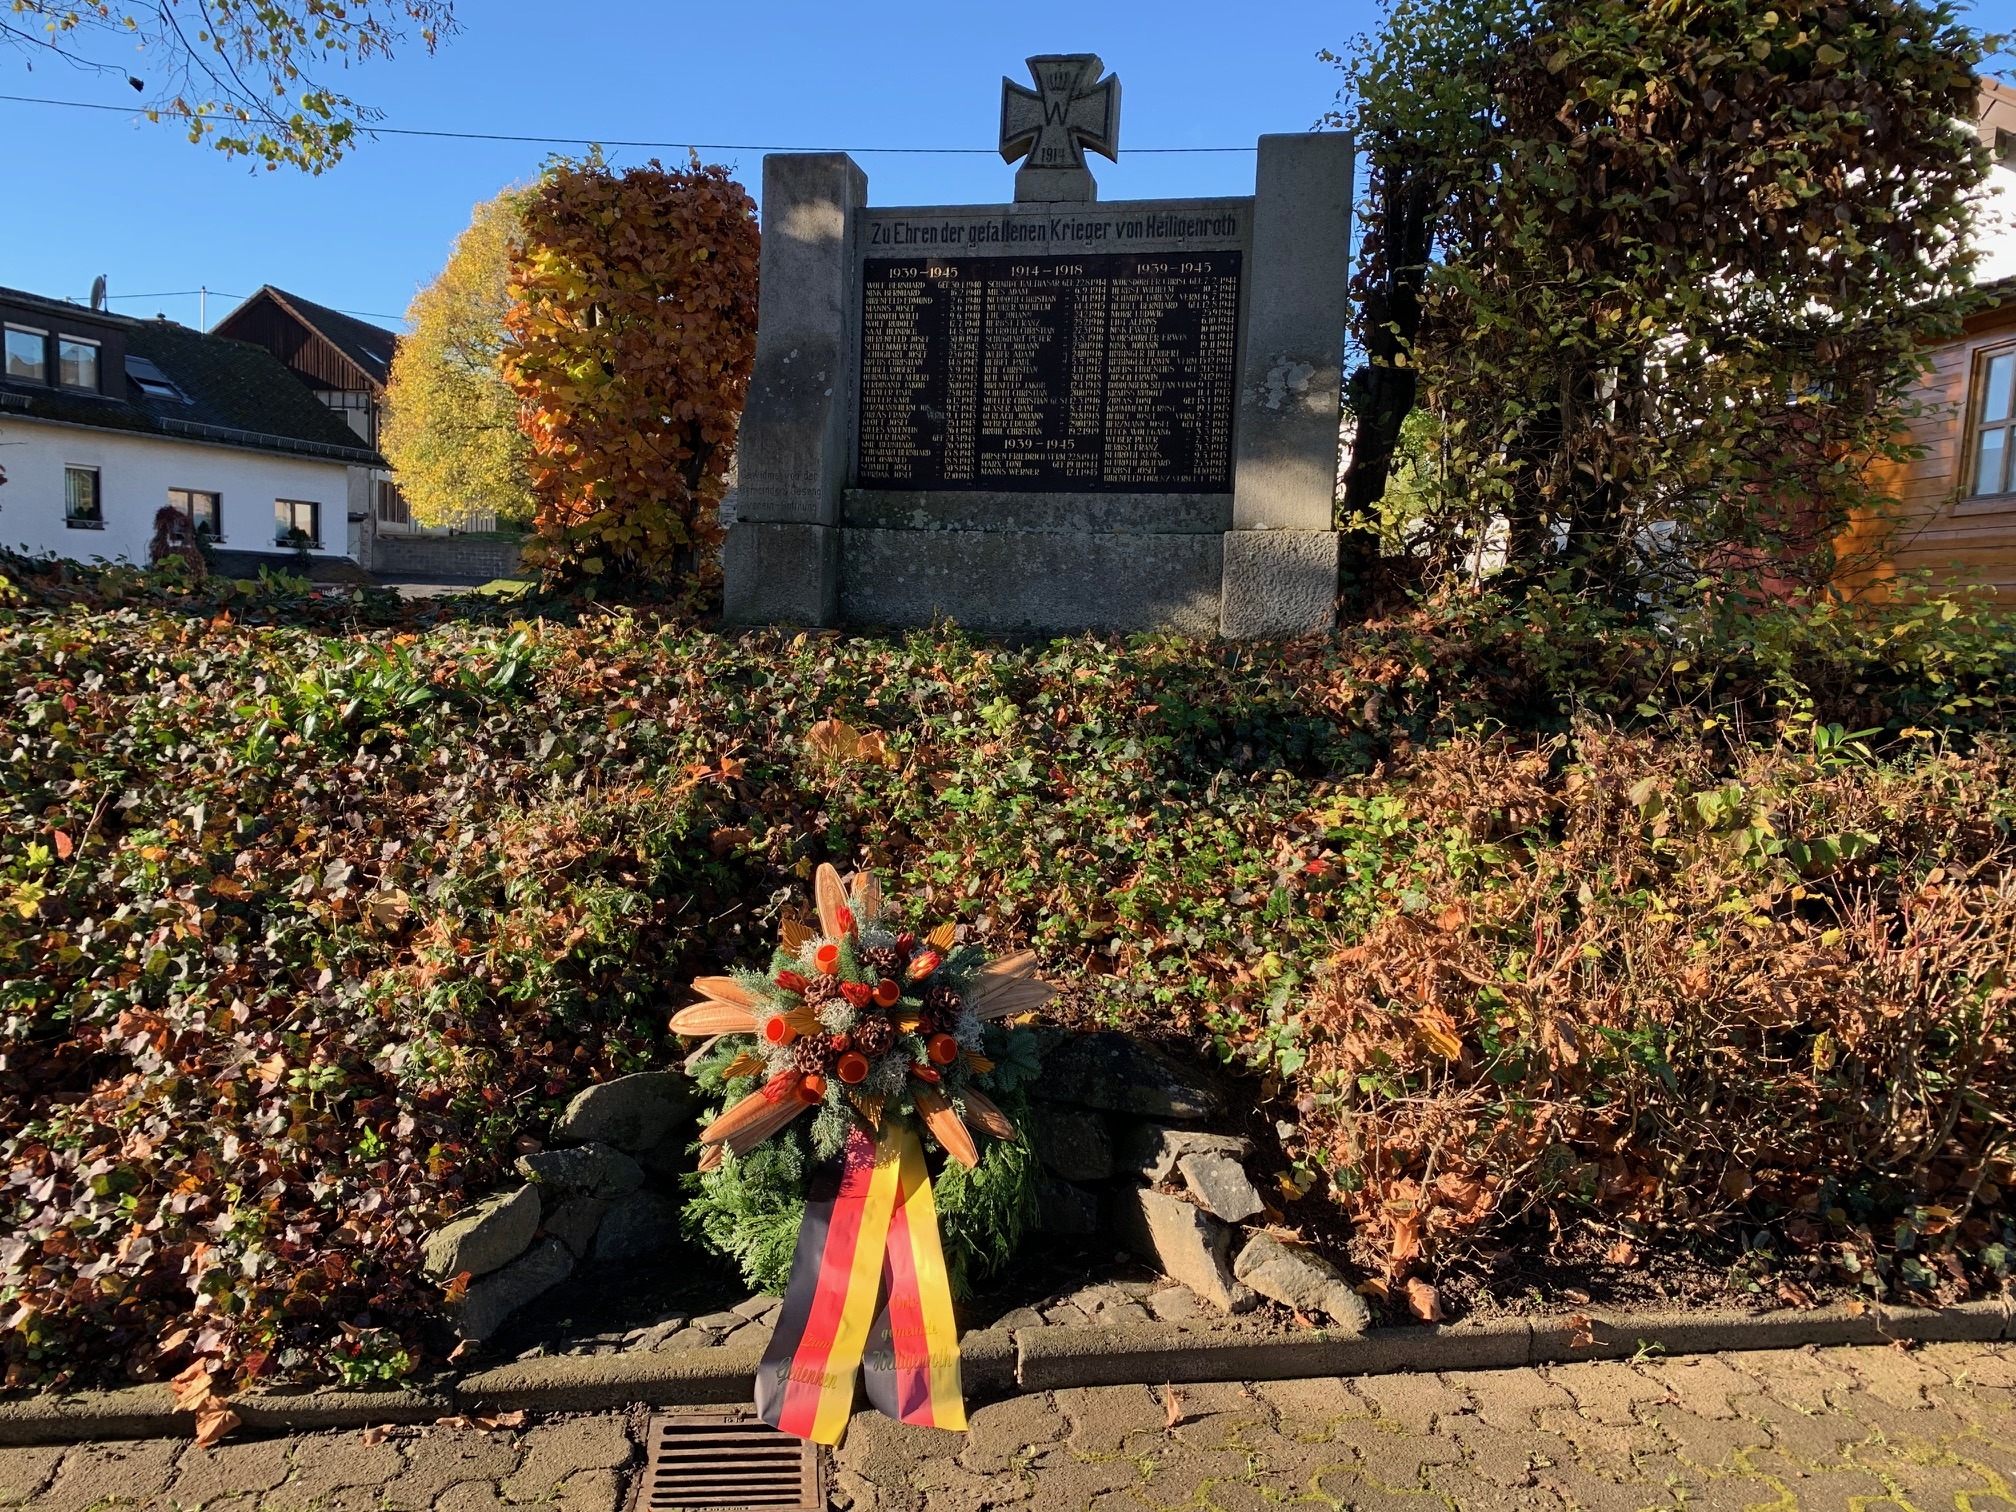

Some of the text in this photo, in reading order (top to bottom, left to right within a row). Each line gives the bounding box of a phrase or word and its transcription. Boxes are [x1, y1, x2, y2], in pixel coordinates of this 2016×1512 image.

[1041, 148, 1065, 162] 1914
[894, 218, 937, 244] Ehren
[940, 221, 965, 243] der
[968, 219, 1046, 247] gefallenen
[1050, 218, 1111, 245] Krieger
[1114, 220, 1143, 239] von
[1146, 213, 1236, 242] Heiligenroth
[1020, 294, 1056, 302] CHRISTIAN
[1020, 326, 1055, 334] CHRISTIAN
[1028, 334, 1051, 342] PETER
[1008, 467, 1039, 475] WERNER
[881, 1321, 939, 1342] gemeinde
[801, 1335, 833, 1349] Zum
[872, 1348, 953, 1375] Heiligenroth
[776, 1356, 839, 1389] Gedenken
